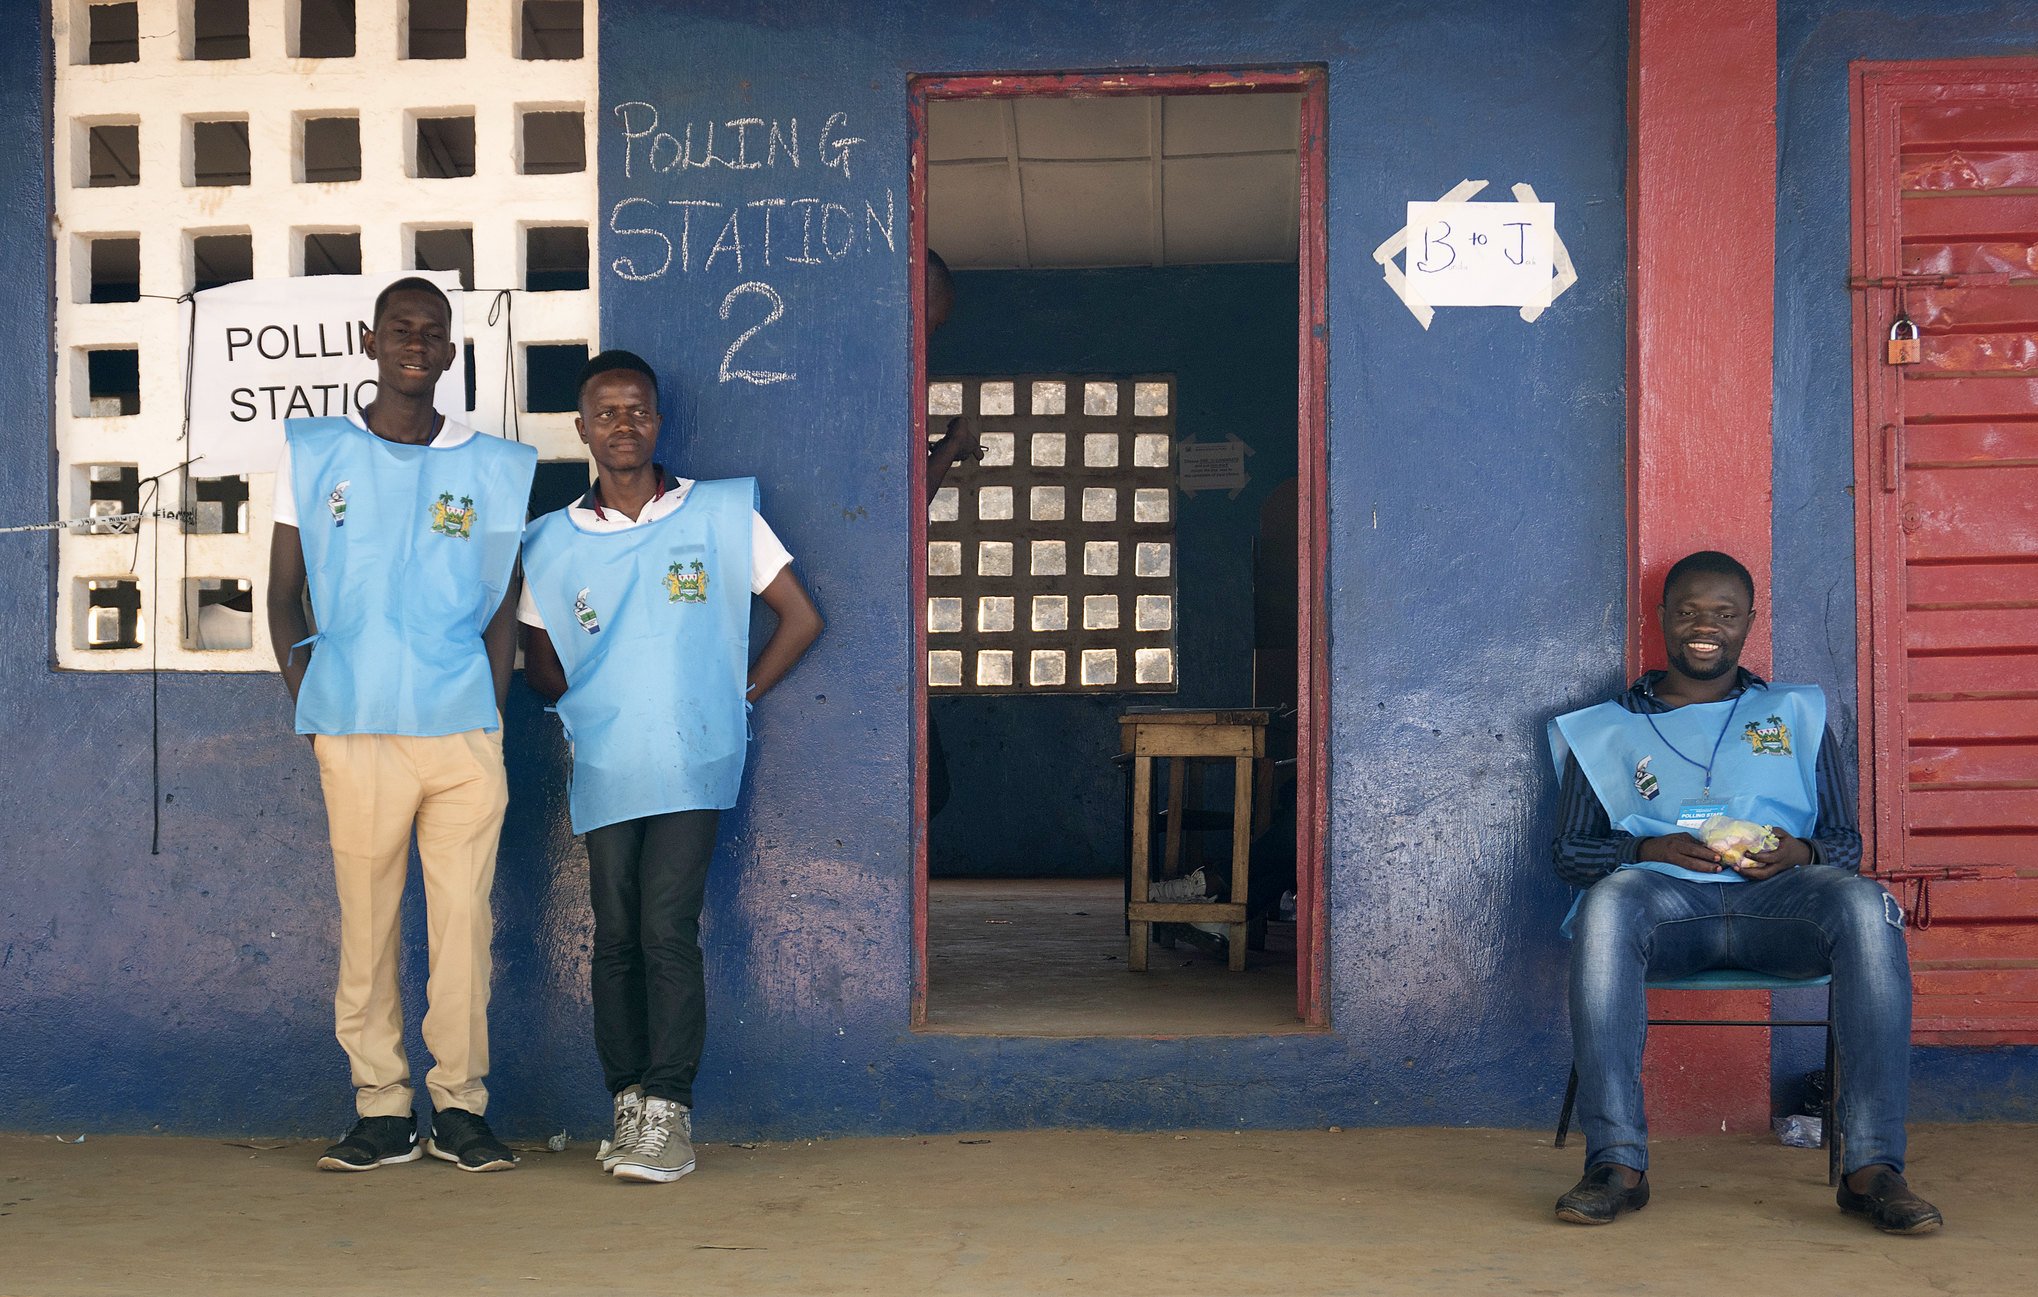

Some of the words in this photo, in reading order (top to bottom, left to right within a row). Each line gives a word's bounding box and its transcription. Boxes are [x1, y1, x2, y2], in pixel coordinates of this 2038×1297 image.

[613, 101, 867, 178] POLLING
[610, 187, 895, 281] STATION
[1416, 220, 1456, 273] B
[1468, 232, 1488, 246] to
[1502, 222, 1532, 265] J
[225, 319, 375, 361] POLLI
[718, 281, 797, 385] 2
[229, 379, 379, 422] STATIO
